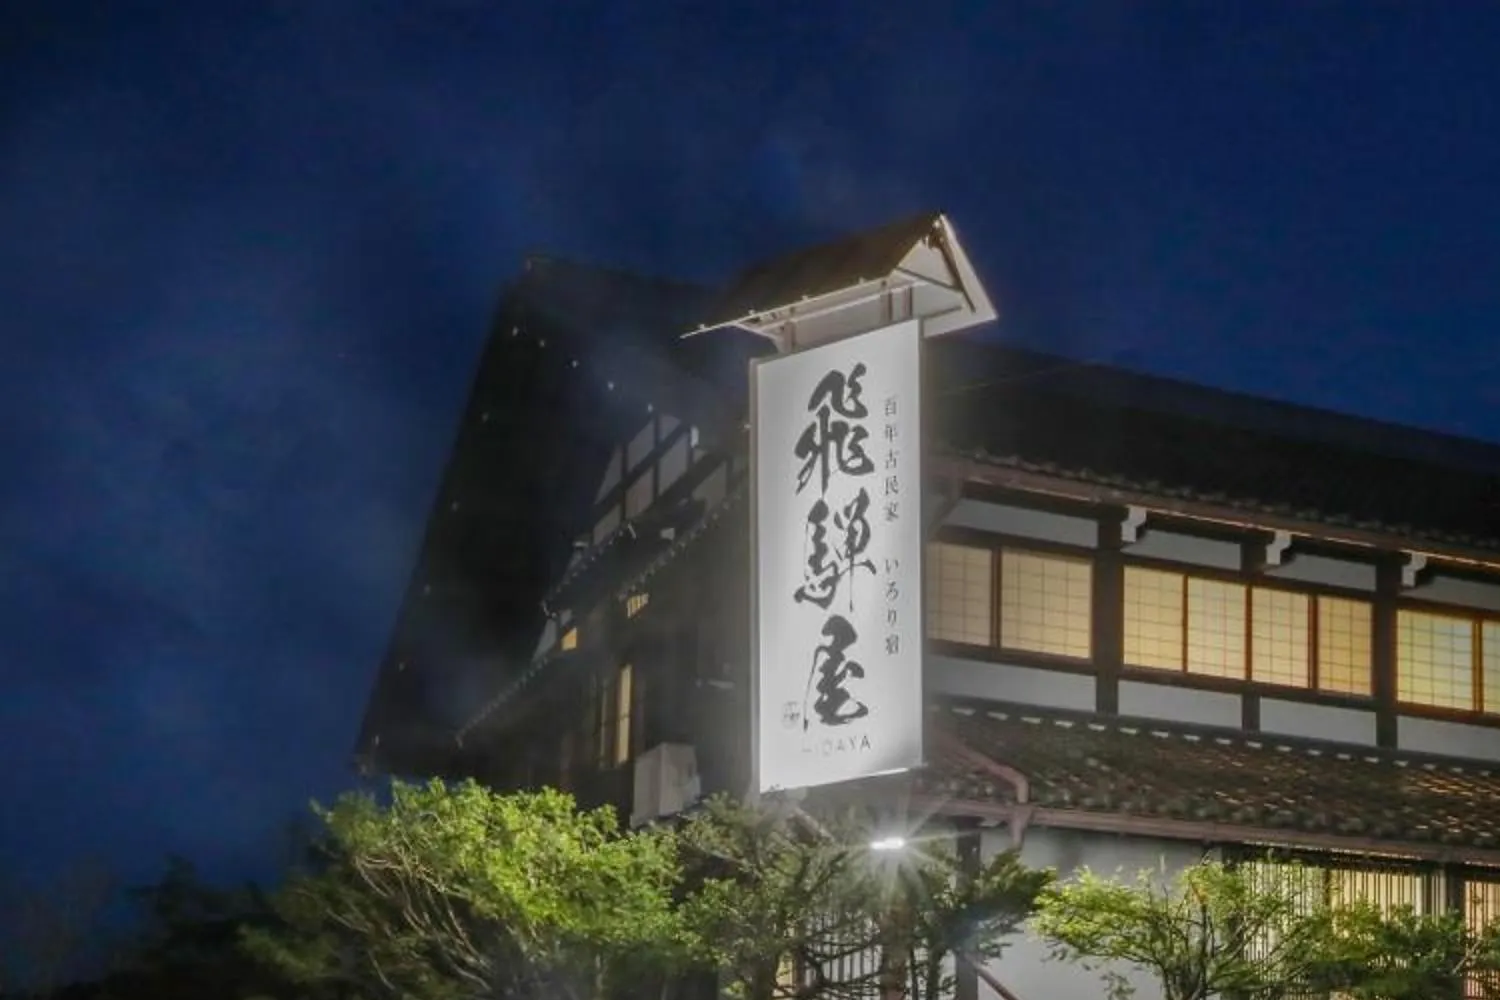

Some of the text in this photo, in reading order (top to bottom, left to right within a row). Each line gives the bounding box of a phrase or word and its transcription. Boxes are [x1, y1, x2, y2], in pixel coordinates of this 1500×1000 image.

[794, 362, 876, 732] 飛騨屋
[884, 398, 900, 656] 百年古民家 いろり宿
